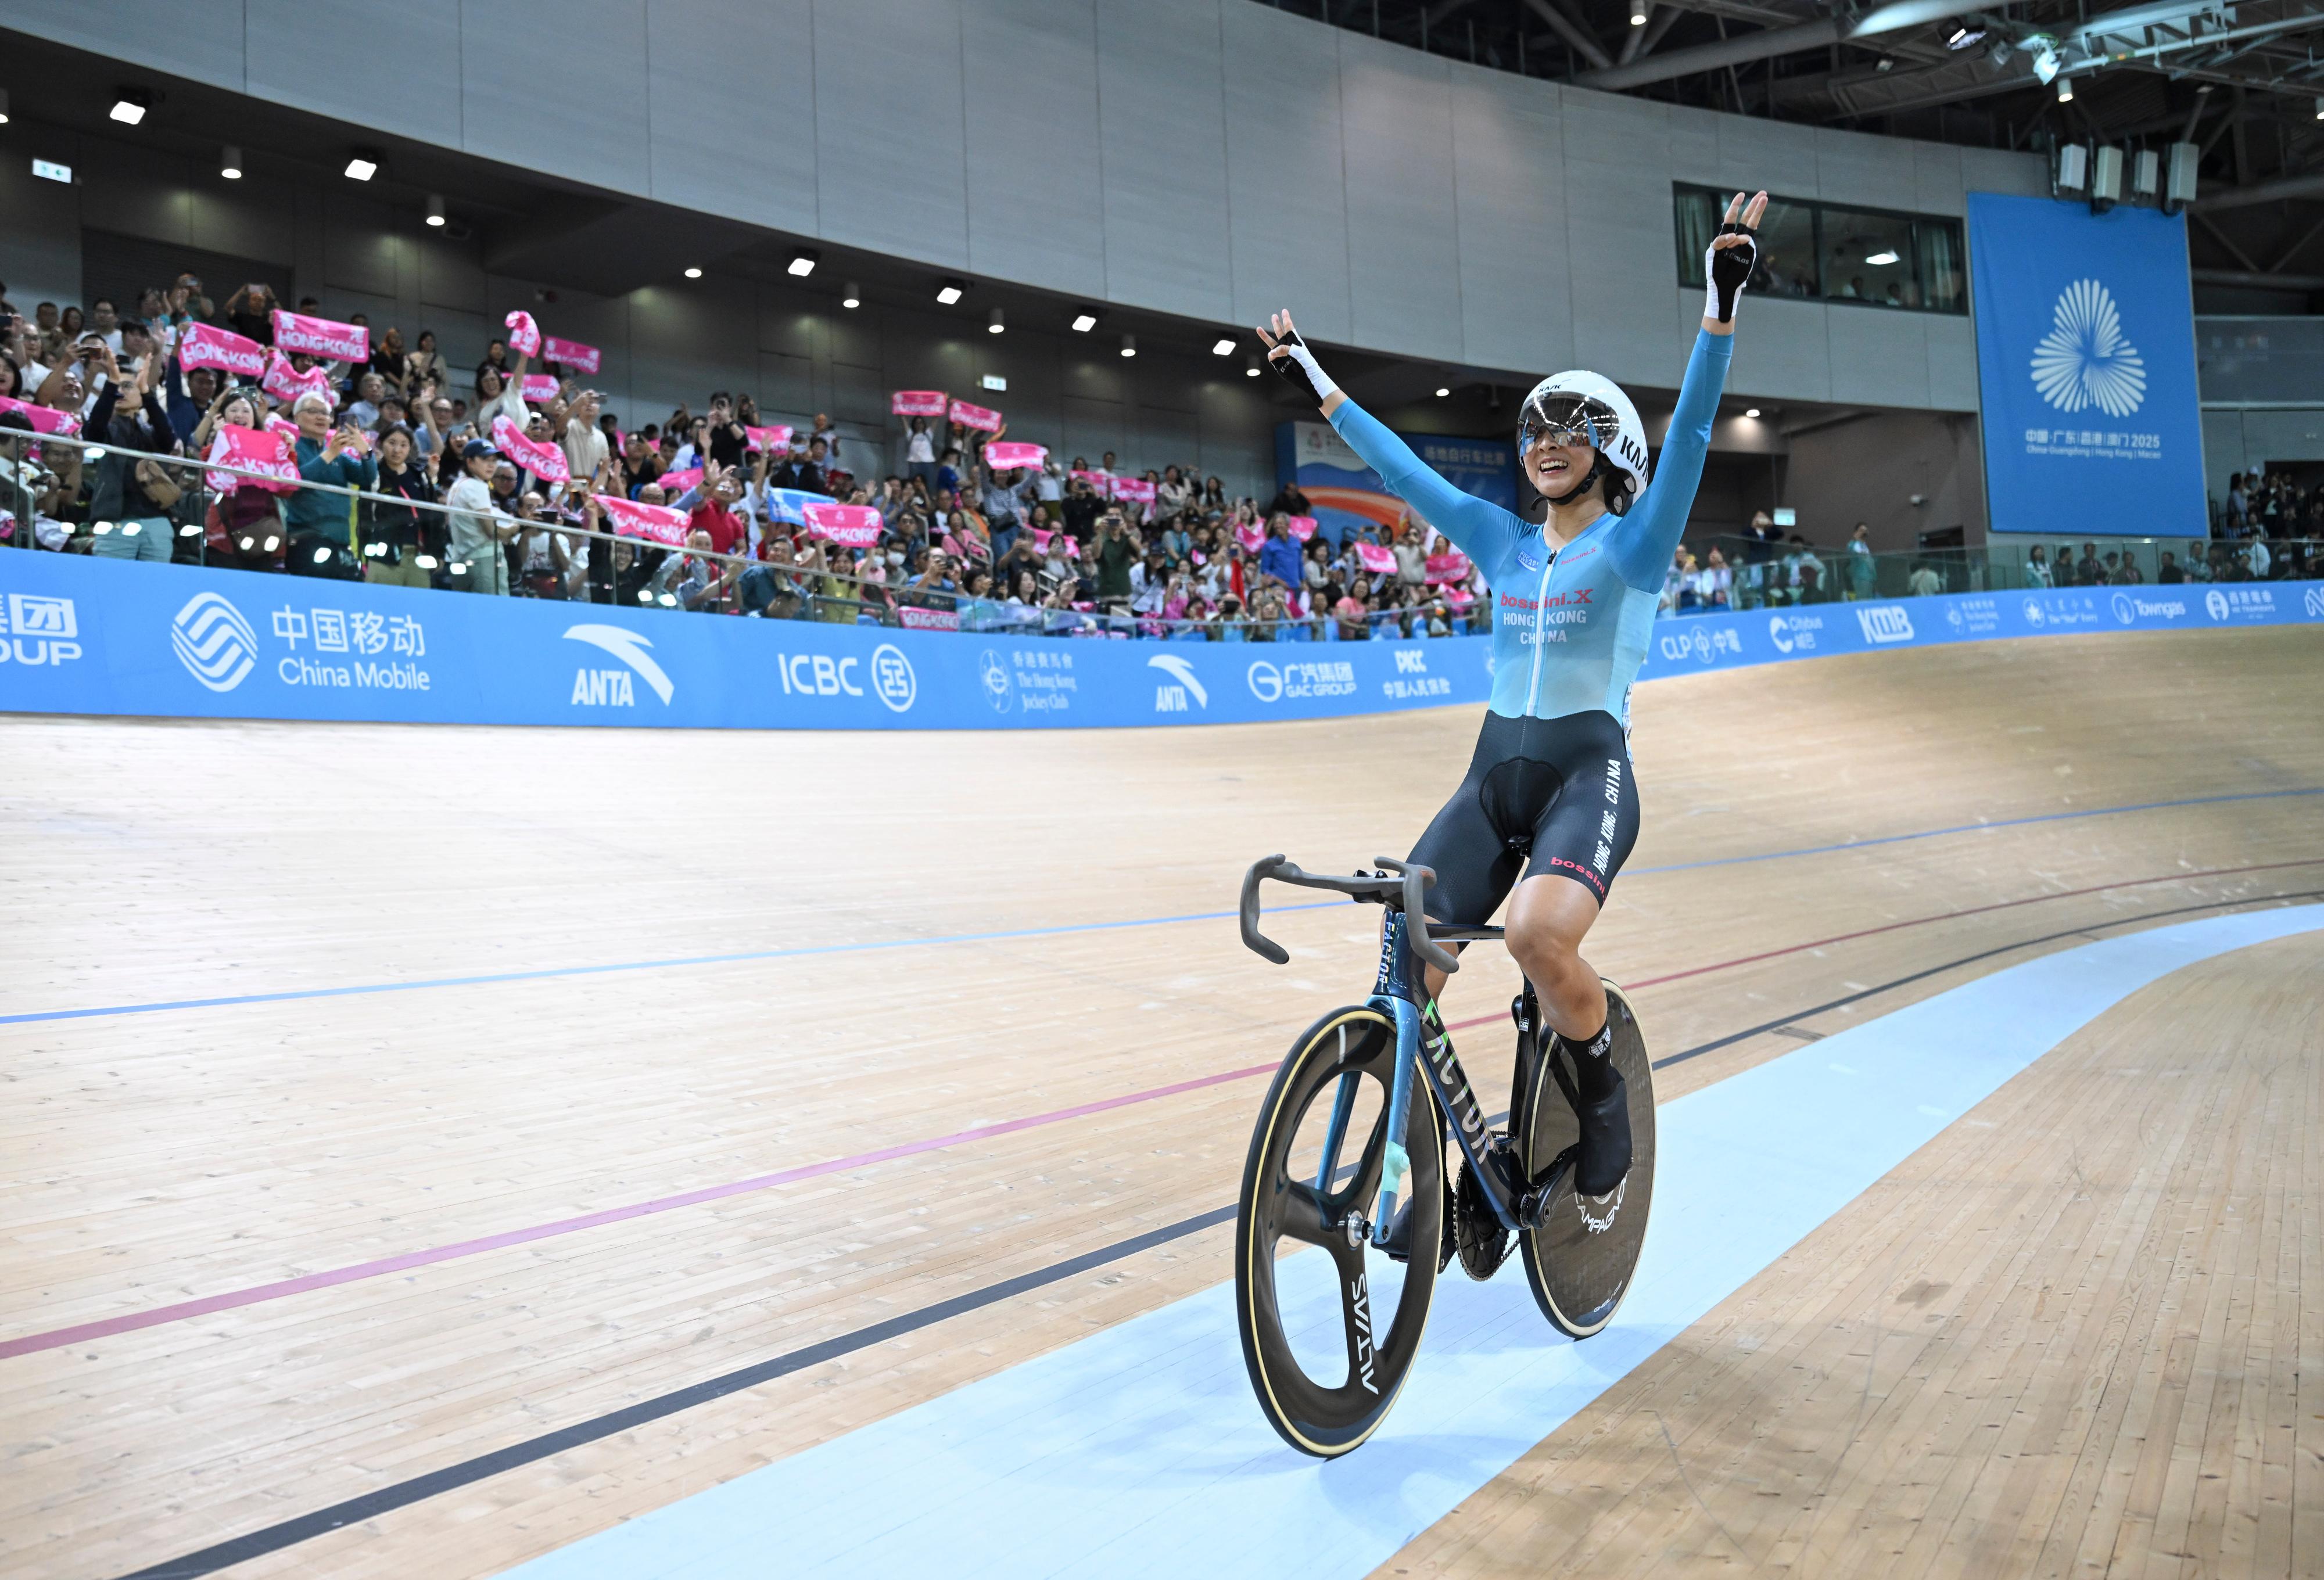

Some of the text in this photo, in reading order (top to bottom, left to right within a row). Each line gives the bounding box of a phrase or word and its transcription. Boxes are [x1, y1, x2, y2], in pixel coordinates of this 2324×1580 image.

[181, 342, 265, 369] HONGKON
[2131, 433, 2160, 449] 2025
[1561, 546, 1598, 566] bossini.X
[1501, 588, 1594, 610] bossini.X
[2133, 599, 2186, 619] Towngas
[0, 593, 78, 638] 团
[1503, 609, 1587, 627] HONG KONG
[1856, 606, 1914, 644] KMB
[271, 604, 425, 658] 中国移动
[1519, 630, 1567, 645] CHINA
[1660, 634, 1691, 660] CLP
[278, 657, 431, 691] China Mobile
[778, 653, 864, 696] ICBC
[1017, 672, 1032, 688] The
[1283, 662, 1355, 684] 广汽集团
[571, 669, 634, 706] ANTA
[1155, 686, 1188, 712] ANTA
[1285, 681, 1357, 698] GAC GROUP
[1593, 840, 1611, 876] HONG
[1605, 759, 1621, 805] CHINA
[1378, 921, 1395, 984] FACTOR
